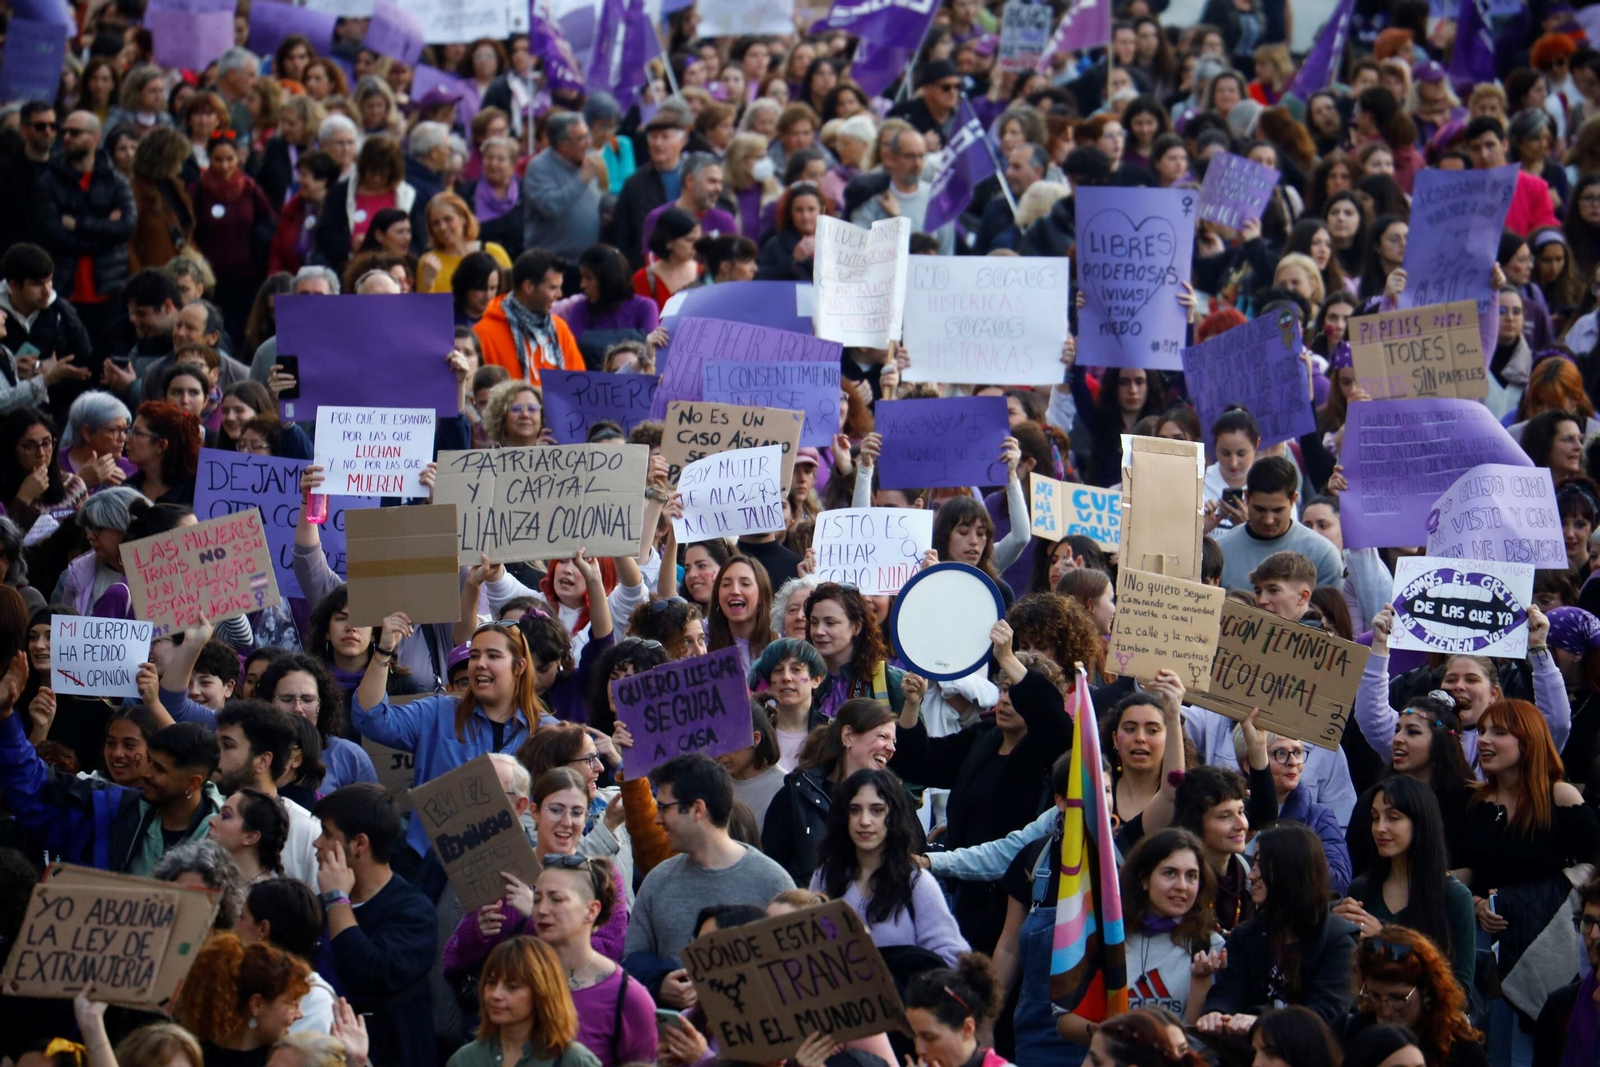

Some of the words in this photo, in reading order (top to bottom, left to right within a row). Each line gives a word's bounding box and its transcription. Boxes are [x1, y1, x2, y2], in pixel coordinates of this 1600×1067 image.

[1090, 232, 1173, 260] LIBRES
[914, 263, 949, 290] NO
[976, 265, 1058, 290] SOMOS
[1082, 262, 1178, 286] PODEROSAS
[945, 316, 1025, 340] SOMOS
[1384, 335, 1445, 365] TODES
[706, 365, 728, 392] EL
[728, 365, 840, 391] CONSENTIMIENTO
[1438, 366, 1486, 385] PAPELES
[331, 411, 351, 425] POR
[355, 409, 376, 425] QUÉ
[380, 412, 389, 424] TE
[393, 413, 431, 425] ESPANTAS
[710, 408, 729, 424] ES
[742, 411, 764, 428] UN
[342, 430, 362, 442] POR
[368, 430, 387, 442] LAS
[392, 430, 412, 442] QUE
[677, 429, 721, 446] CASO
[328, 458, 335, 472] Y
[343, 459, 357, 470] NO
[364, 459, 382, 470] POR
[385, 459, 401, 470] LAS
[403, 458, 421, 469] QUE
[355, 445, 402, 459] LUCHAN
[346, 474, 404, 493] MUEREN
[683, 465, 712, 487] SOY
[467, 482, 480, 503] Y
[1459, 475, 1505, 504] ELIJO
[1510, 475, 1547, 498] COMO
[458, 506, 540, 552] LIANZA
[684, 514, 709, 537] NO
[737, 501, 784, 531] TALLAS
[821, 513, 875, 540] ESTO
[885, 514, 909, 540] ES
[1451, 507, 1502, 535] VISTO
[1509, 507, 1523, 527] Y
[1525, 507, 1556, 529] CON
[133, 538, 179, 569] LAS
[182, 514, 261, 551] MUJERES
[1472, 540, 1495, 561] ME
[1503, 539, 1564, 562] DESVISTO
[137, 558, 189, 585] TRANS
[199, 547, 227, 564] NO
[233, 538, 263, 555] SON
[819, 543, 878, 568] PELEAR
[1398, 560, 1426, 573] NOS
[1435, 559, 1496, 573] QUEREMOS
[1502, 565, 1533, 578] VIVAS
[146, 582, 174, 600] UN
[184, 557, 257, 589] PELIGRO
[210, 578, 239, 596] EN
[1402, 570, 1443, 601] SOMOS
[1452, 571, 1471, 586] EL
[1480, 576, 1521, 613] GRITO
[1147, 581, 1181, 597] quiero
[1183, 587, 1213, 604] seguir
[173, 593, 251, 628] PELIGRO
[1119, 606, 1131, 615] de
[1133, 609, 1159, 619] vuelta
[1182, 603, 1215, 616] ansiedad
[1414, 600, 1435, 615] DE
[1442, 604, 1466, 619] LAS
[1468, 609, 1493, 624] QUE
[1496, 612, 1514, 626] YA
[59, 621, 77, 637] MI
[83, 621, 129, 640] CUERPO
[129, 623, 149, 642] NO
[1116, 619, 1132, 637] La
[1135, 625, 1159, 639] calle
[1163, 632, 1169, 643] y
[1172, 628, 1181, 641] la
[1184, 633, 1208, 645] noche
[1400, 613, 1417, 631] NO
[1423, 630, 1474, 652] TIENEN
[1483, 628, 1507, 645] VOZ
[59, 644, 78, 663] HA
[83, 643, 127, 662] PEDIDO
[1154, 648, 1168, 656] son
[87, 665, 131, 687] OPINIÓN
[618, 669, 681, 706] QUIERO
[683, 655, 740, 688] LLEGAR
[644, 684, 727, 735] SEGURA
[653, 743, 668, 761] A
[678, 730, 719, 752] CASA
[423, 790, 460, 828] EN
[460, 776, 491, 808] EL
[35, 896, 75, 921] YO
[27, 923, 58, 946] LA
[71, 926, 119, 954] LEY
[122, 930, 155, 961] DE
[687, 936, 763, 984] ¿DÓNDE
[756, 939, 875, 1006] TRANS
[719, 1020, 754, 1048] EN
[759, 1017, 794, 1046] EL
